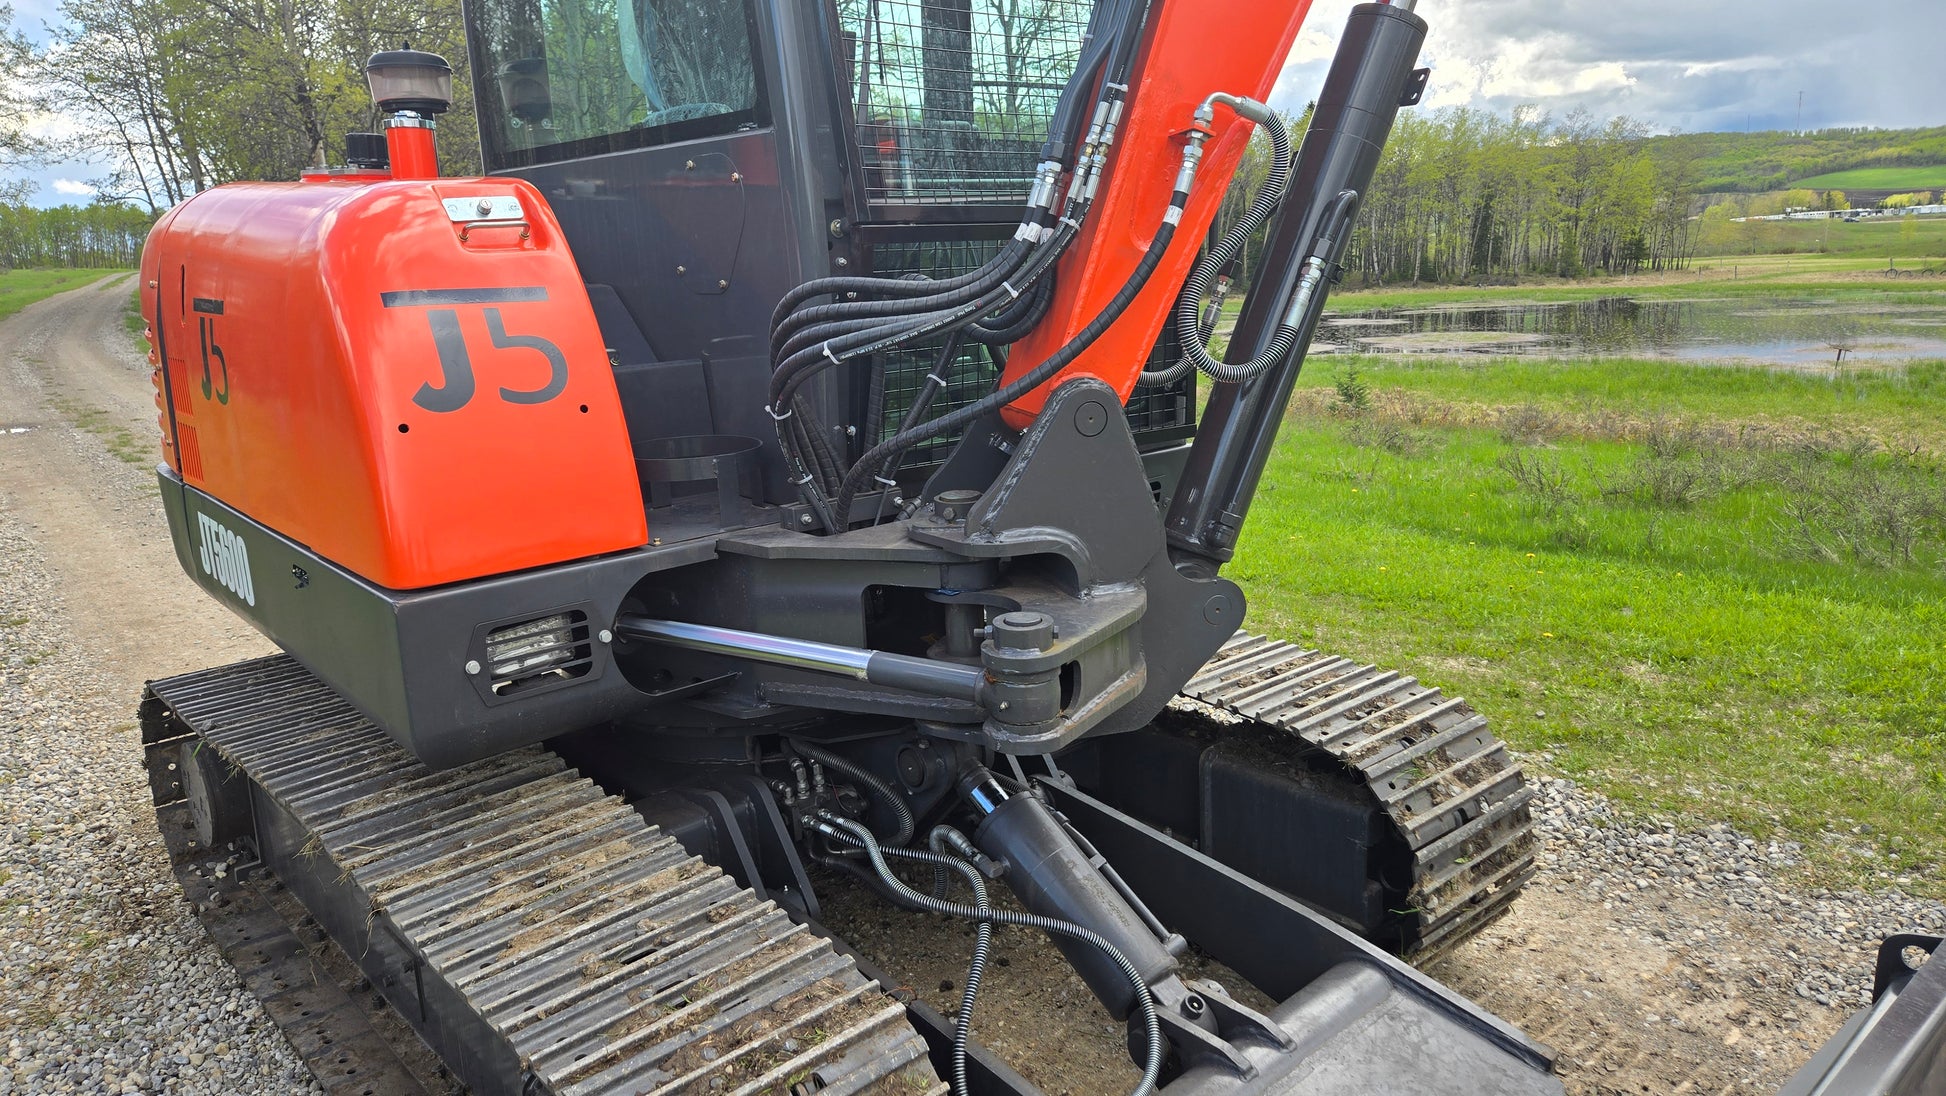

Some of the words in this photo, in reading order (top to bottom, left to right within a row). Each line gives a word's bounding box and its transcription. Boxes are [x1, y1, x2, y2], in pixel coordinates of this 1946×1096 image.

[193, 298, 229, 405] J5
[380, 286, 569, 413] J5
[197, 511, 255, 607] JT5600
